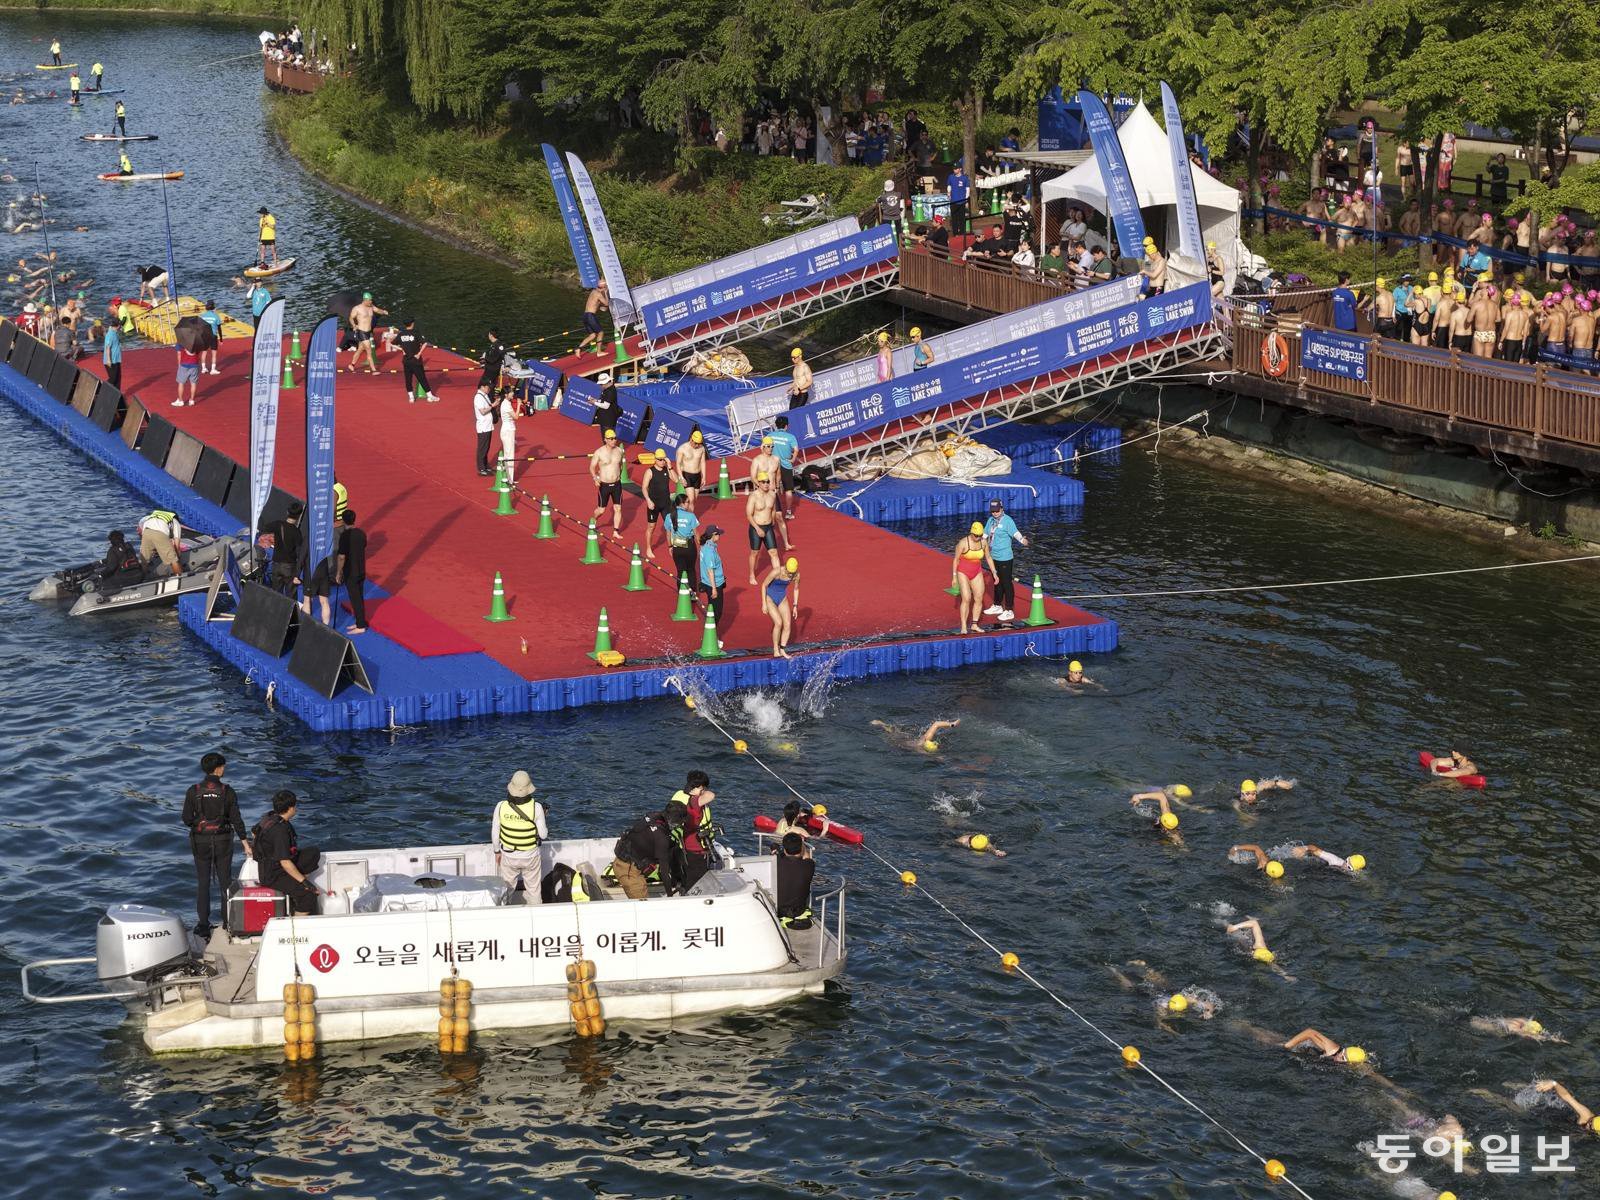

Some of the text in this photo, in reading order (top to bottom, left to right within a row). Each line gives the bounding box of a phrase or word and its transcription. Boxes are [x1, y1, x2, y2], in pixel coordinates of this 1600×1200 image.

[1166, 306, 1194, 321] LAKE SWIM
[1093, 320, 1110, 331] LOTTE
[1120, 324, 1139, 337] LAKE
[1079, 329, 1112, 345] AQUATHLON
[911, 385, 942, 402] LAKE SWIM
[833, 402, 852, 414] LOTTE
[863, 405, 884, 420] LAKE
[818, 412, 854, 427] AQUATHLON
[128, 930, 171, 940] HONDA
[353, 926, 724, 966] 오늘을 새롭게, 내일을 이롭게. 롯데
